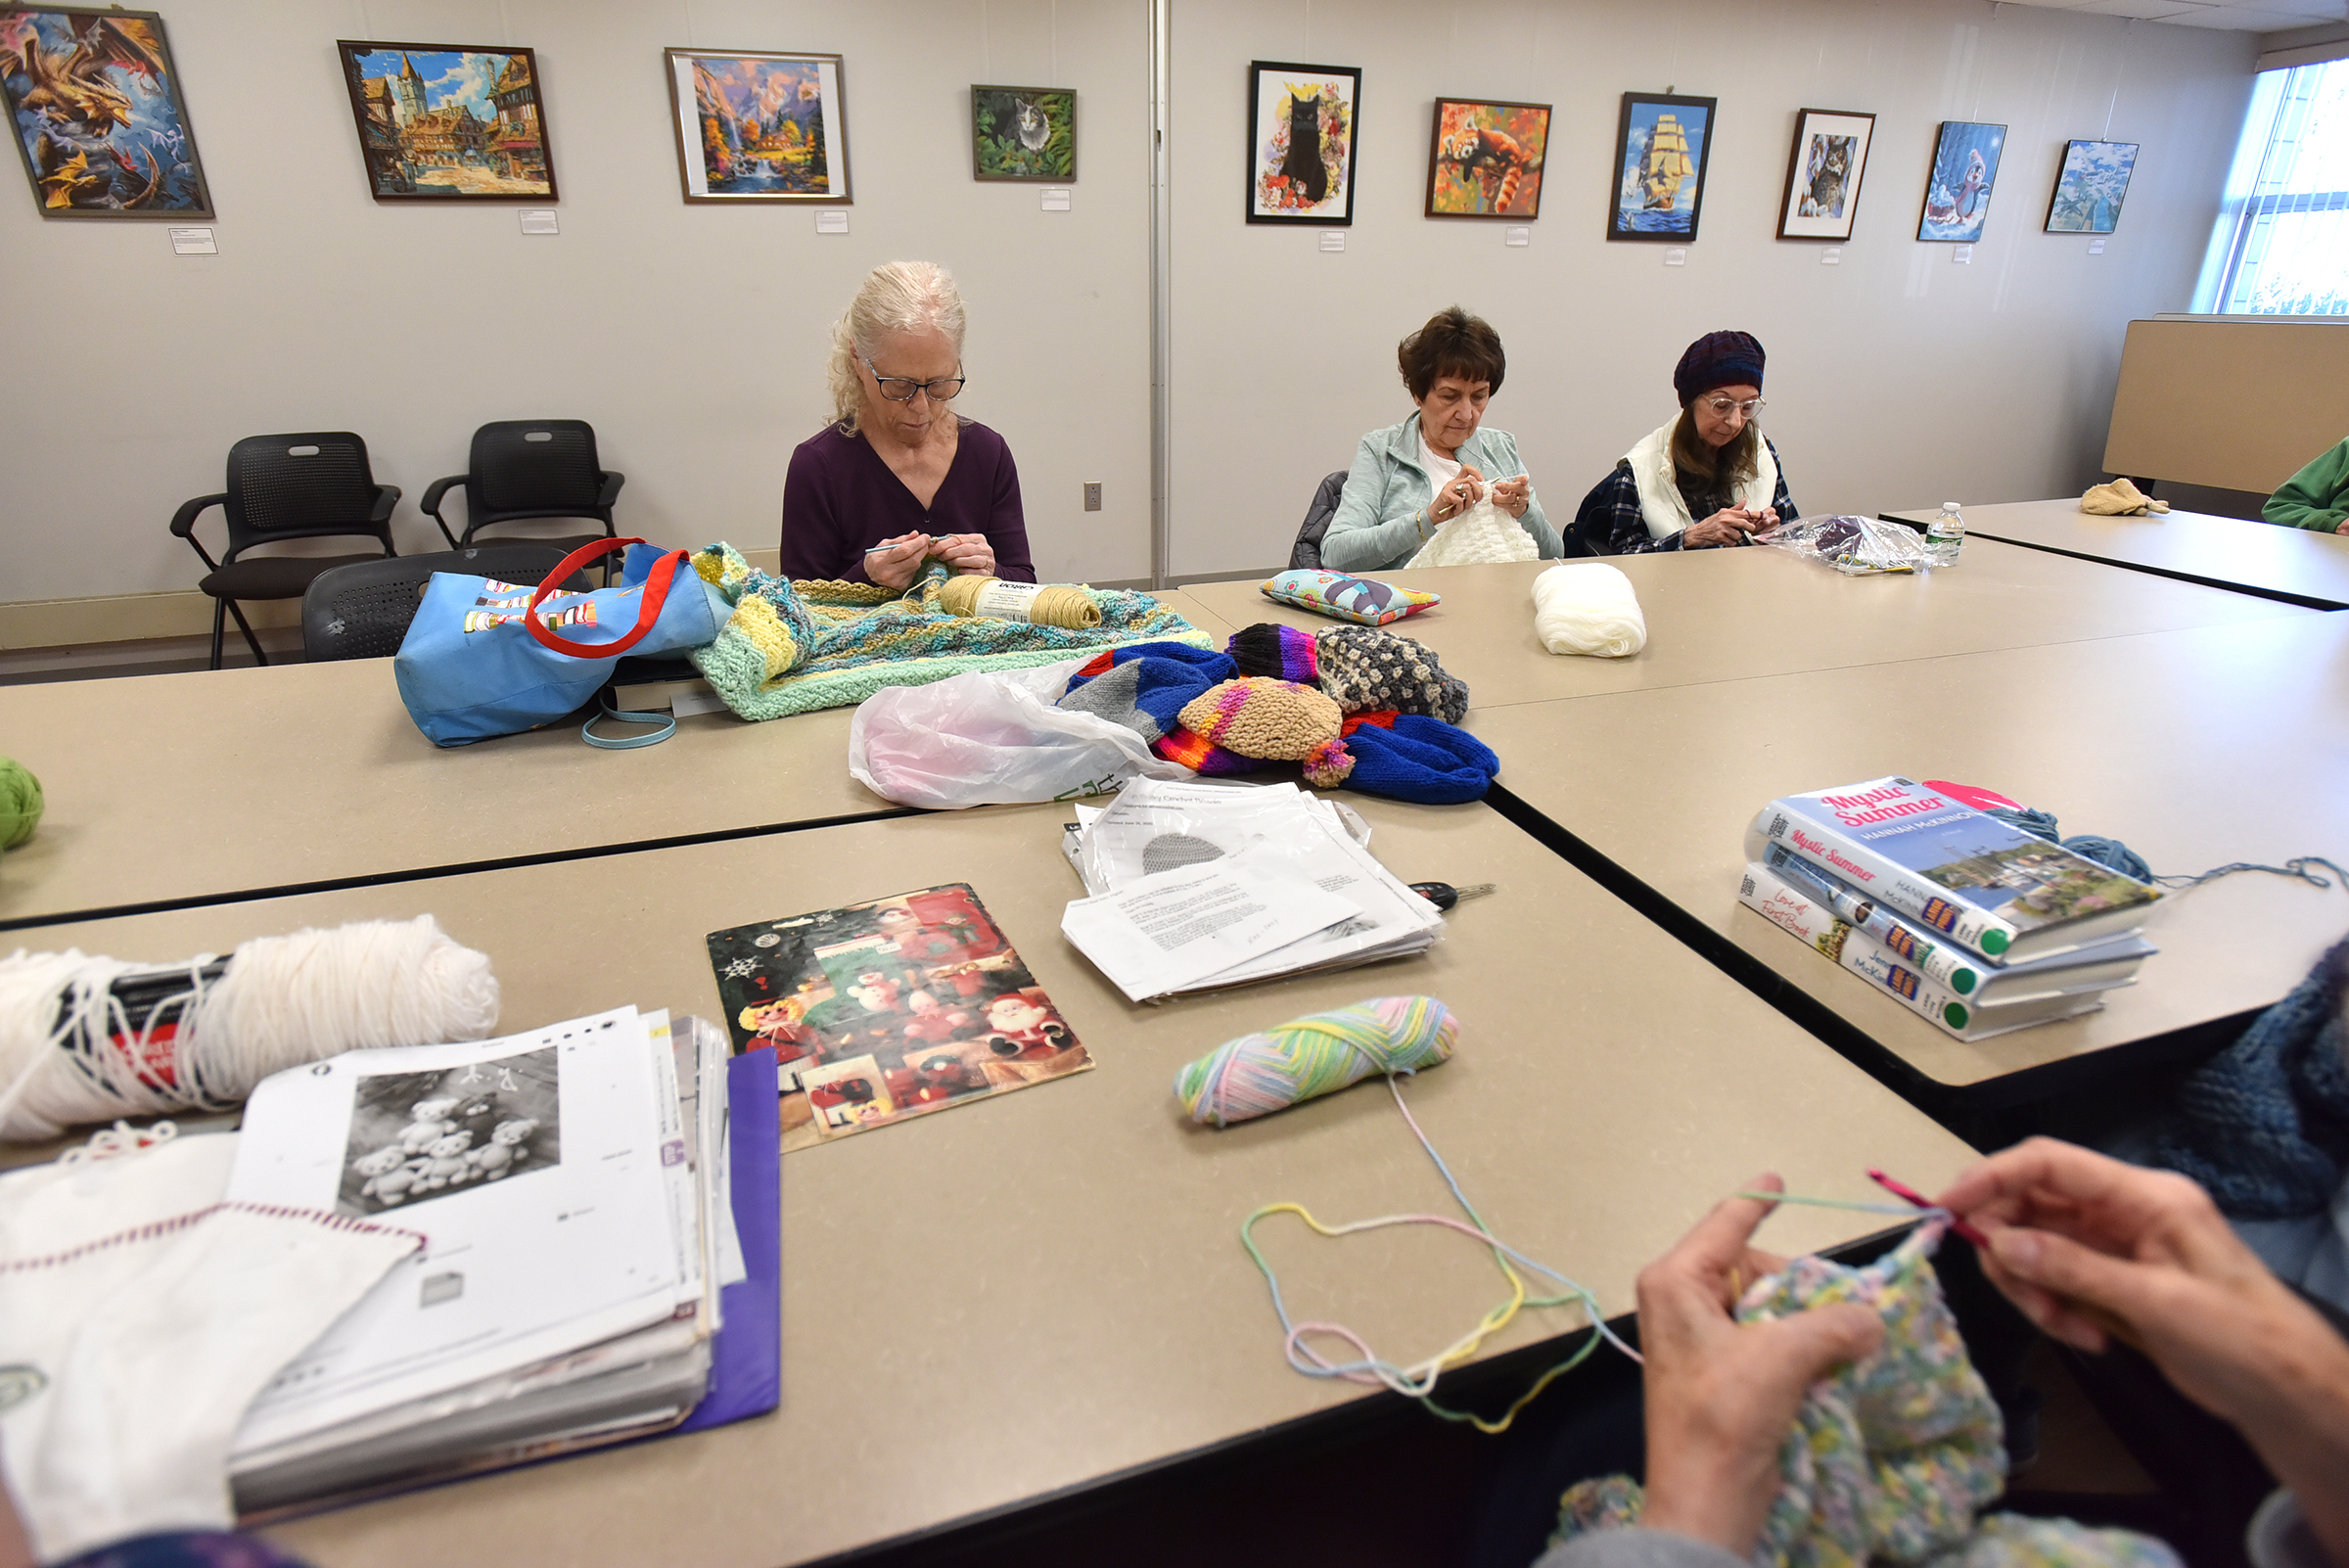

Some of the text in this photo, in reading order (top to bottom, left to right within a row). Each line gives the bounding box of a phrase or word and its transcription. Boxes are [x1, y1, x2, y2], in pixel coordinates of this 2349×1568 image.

[1820, 785, 1911, 810] Mystic
[1835, 796, 1946, 827] Summer
[1861, 823, 1917, 841] HANNAH
[1790, 829, 1826, 856] Mystic
[1826, 849, 1876, 882] Summer
[1773, 888, 1796, 908] Love
[1762, 899, 1811, 939] First Book
[1854, 957, 1890, 986] McKin
